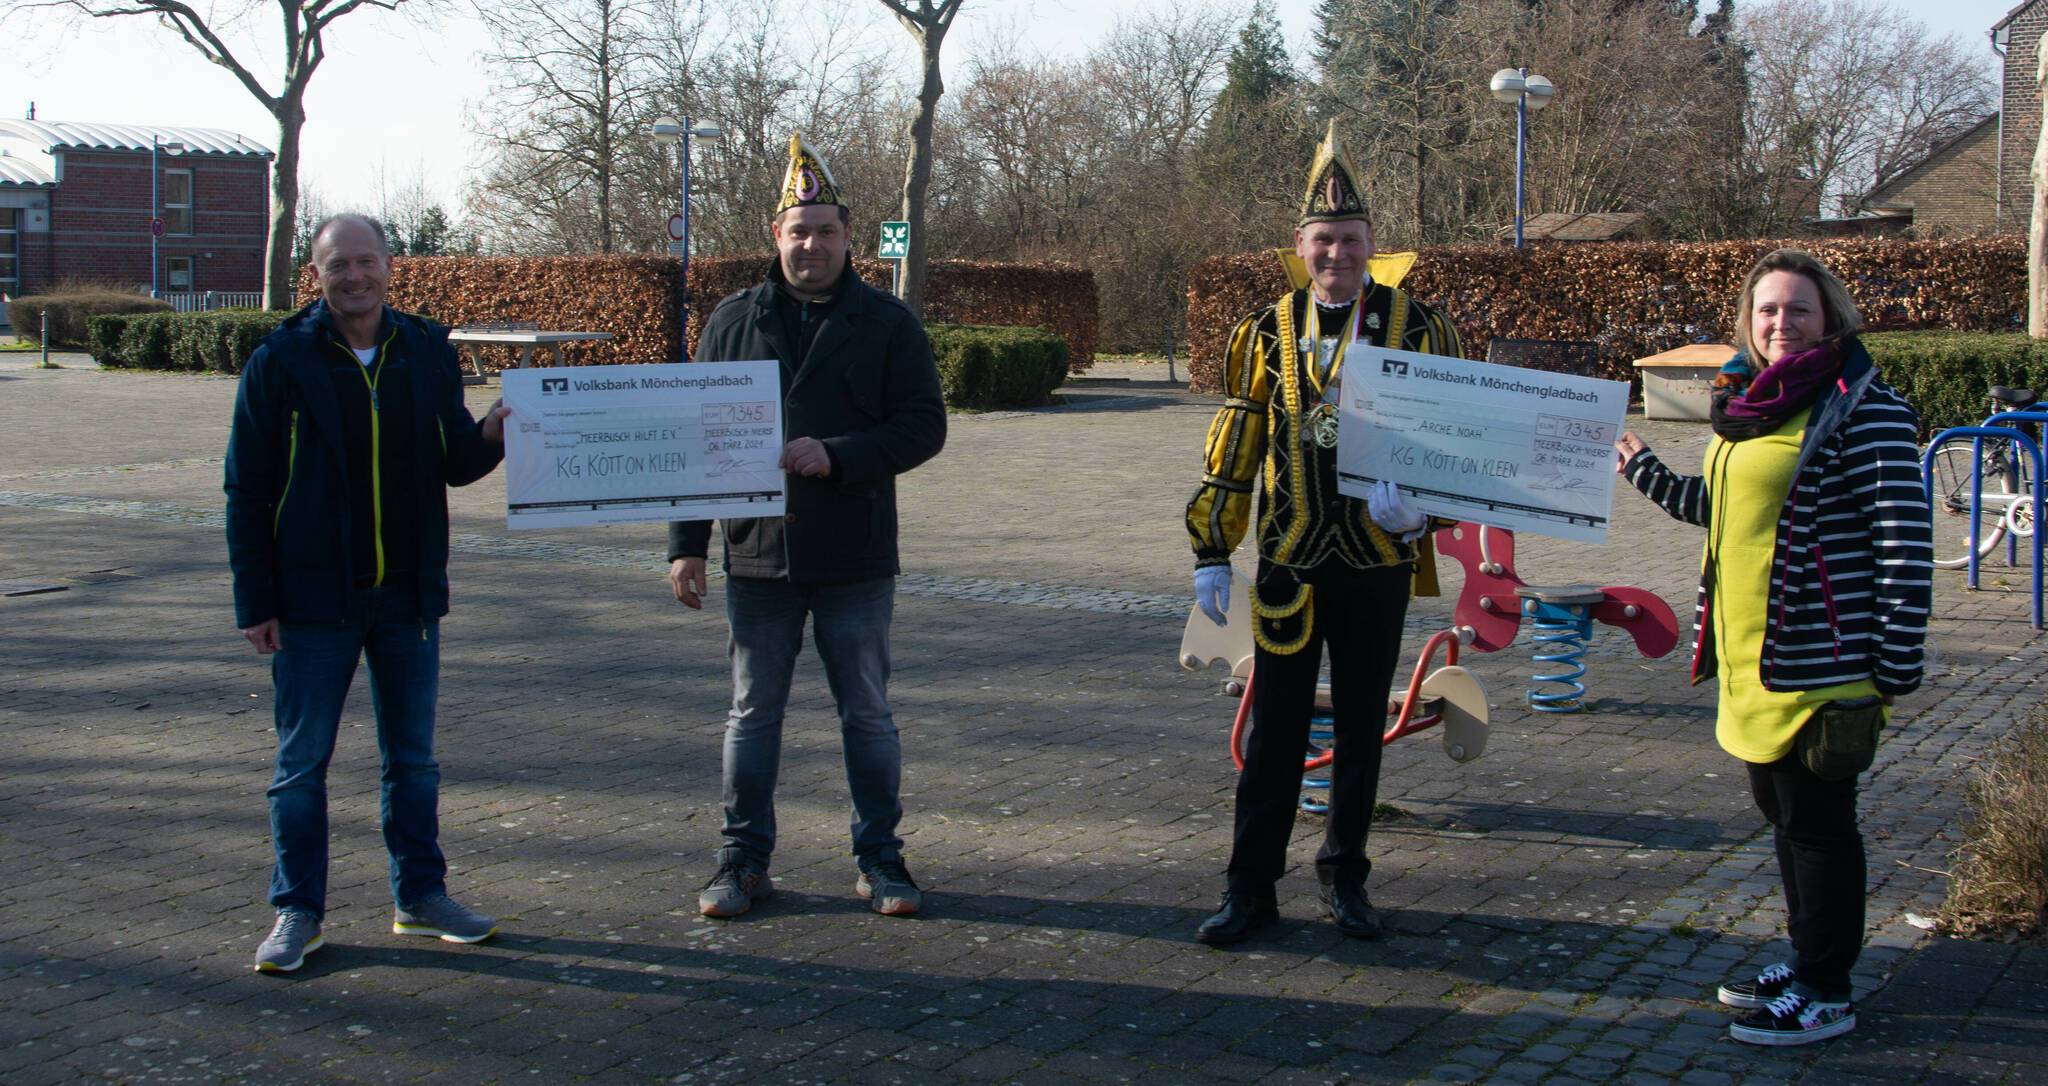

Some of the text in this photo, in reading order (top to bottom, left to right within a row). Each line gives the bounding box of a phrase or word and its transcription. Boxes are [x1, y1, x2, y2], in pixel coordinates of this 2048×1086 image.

[574, 374, 753, 392] Volksbank Mönchengladbach
[1413, 366, 1599, 403] Volksbank Mönchengladbach
[727, 405, 764, 422] 1345
[634, 430, 657, 441] HILFT
[1564, 423, 1605, 441] 1345
[556, 455, 581, 478] KG
[625, 456, 644, 475] ON
[649, 452, 687, 473] KLEEN
[1389, 444, 1415, 466] KG
[1460, 457, 1480, 475] ON
[1481, 458, 1519, 479] KLEEN
